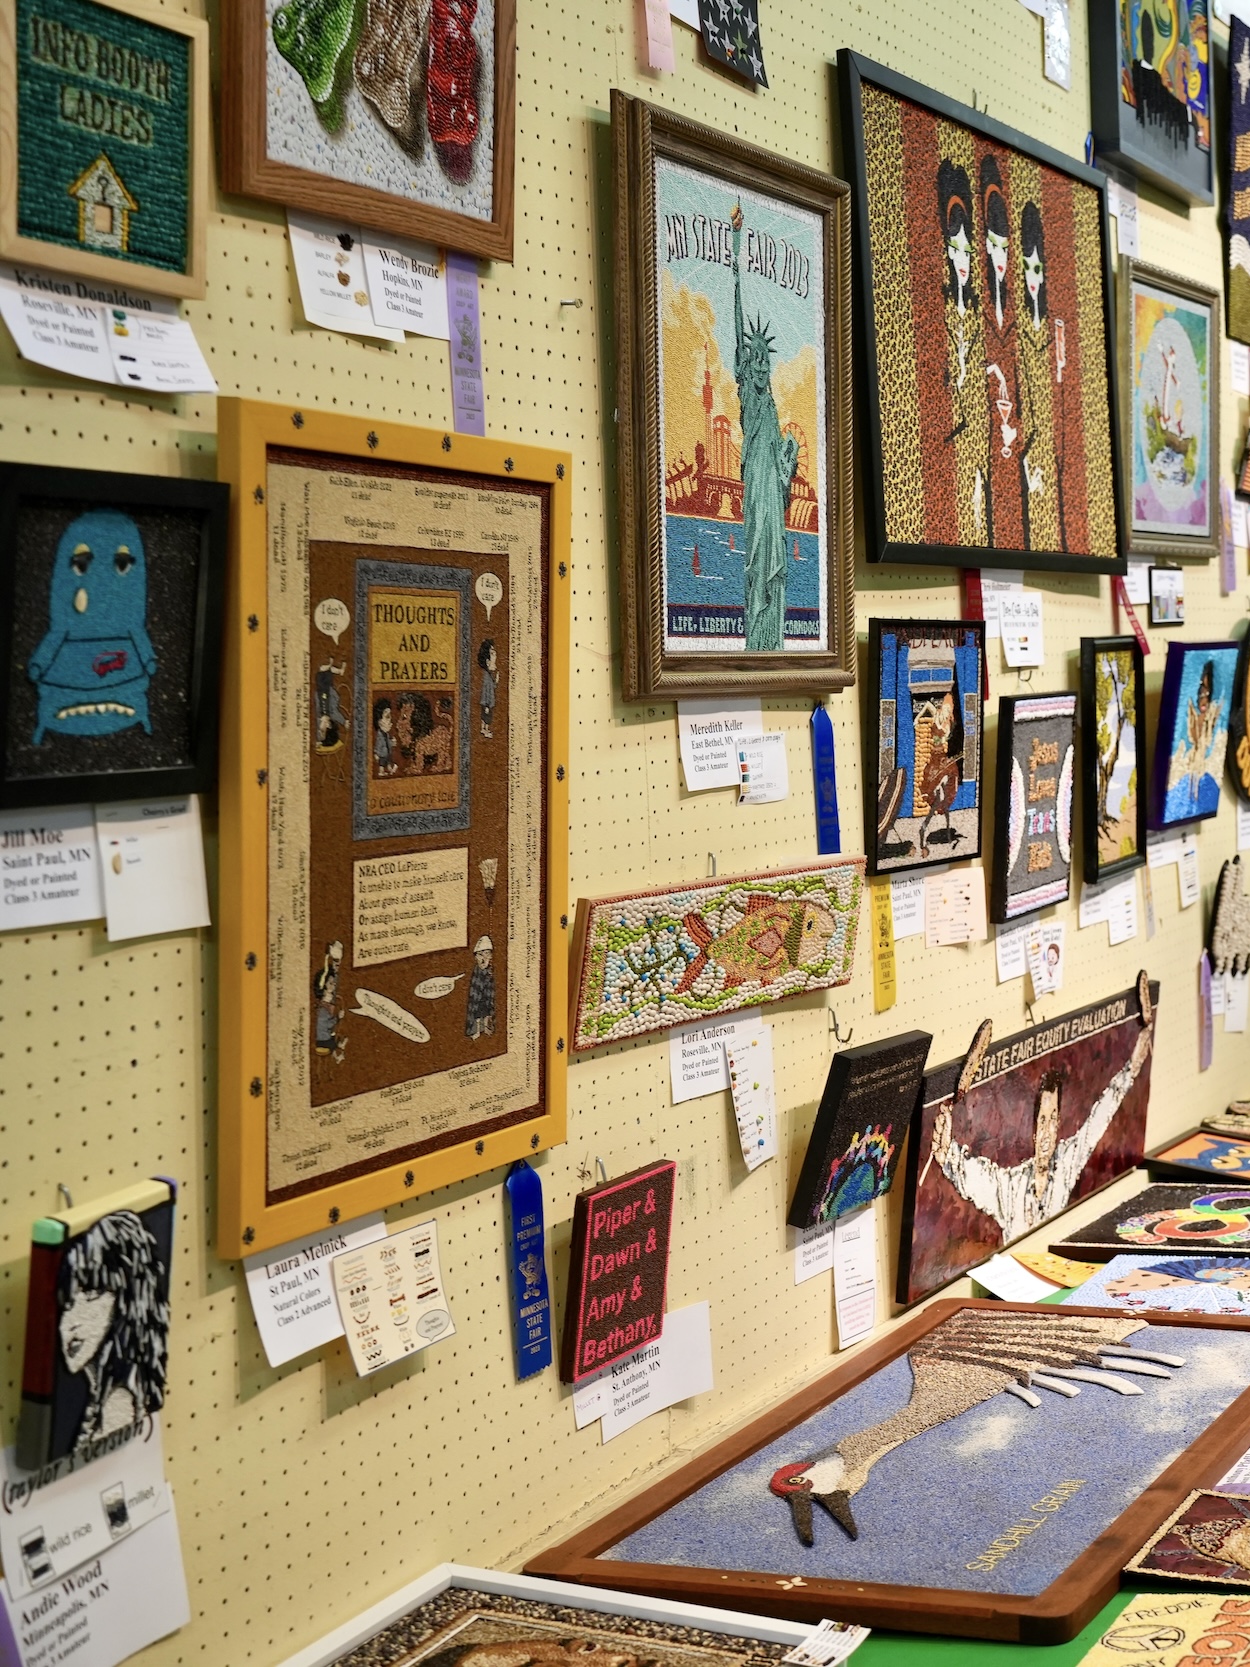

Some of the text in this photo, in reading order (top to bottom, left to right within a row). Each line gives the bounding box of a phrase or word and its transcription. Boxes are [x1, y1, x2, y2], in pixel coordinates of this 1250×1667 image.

[31, 16, 171, 101] INFO BOOTH
[60, 83, 152, 145] LADIES
[378, 249, 410, 276] Wendy
[664, 212, 810, 300] MN STATE FAIR 2023
[14, 269, 154, 312] Kristen Donaldson
[381, 269, 424, 292] Hopkins, MN
[20, 293, 99, 322] Roseville, MN
[384, 286, 423, 307] Dyed Painted
[386, 300, 401, 313] Class
[405, 306, 424, 320] Amateur
[27, 314, 96, 338] Dyed or Painted
[32, 330, 55, 345] Class
[63, 338, 100, 354] Amateur
[454, 365, 482, 382] MINNESOTA
[460, 380, 478, 394] STATE
[463, 393, 476, 406] FAIR
[327, 602, 344, 616] don't
[372, 603, 456, 626] THOUGHTS
[321, 619, 338, 632] care
[671, 616, 821, 636] LIFE, LIBERTY & CORNDOGS
[398, 633, 430, 653] AND
[380, 660, 449, 681] PRAYERS
[689, 718, 744, 737] Meredith Keller
[691, 736, 725, 750] East Bethel,
[693, 750, 728, 764] Dyed Painted
[694, 764, 706, 774] Class
[710, 761, 729, 771] Amateur
[1028, 808, 1056, 836] Trans
[1, 827, 65, 850] Jill Moe
[2, 853, 33, 872] Saint
[36, 850, 67, 868] Paul,
[69, 846, 92, 864] MN
[358, 862, 396, 878] NRA CEO
[3, 871, 78, 892] Dyed or Painted
[891, 879, 908, 891] Marta
[4, 892, 31, 907] Class
[40, 886, 80, 901] Amateur
[892, 888, 922, 902] Saint Paul, MN
[358, 913, 370, 926] Or
[358, 930, 369, 943] As
[880, 961, 891, 970] STATE
[882, 970, 891, 979] FAIR
[681, 1023, 736, 1046] Lori Anderson
[975, 999, 1128, 1082] STATE FAIR EQUITY EVALUATION
[681, 1040, 722, 1060] Roseville, MN
[681, 1061, 695, 1073] Dyed
[702, 1056, 719, 1068] Painted
[682, 1072, 695, 1083] Class
[700, 1066, 720, 1079] Amateur
[521, 1213, 537, 1227] FIRST
[593, 1188, 657, 1240] Piper &
[516, 1225, 541, 1242] PREMIUM
[841, 1227, 861, 1241] Legend
[264, 1234, 348, 1281] Laura Melnick
[589, 1227, 657, 1282] Dawn &
[269, 1266, 322, 1299] St Paul, MN
[272, 1286, 321, 1315] Natural Colors
[519, 1298, 548, 1319] MINNESOTA
[586, 1274, 643, 1327] Amy &
[277, 1312, 295, 1329] Class
[301, 1296, 332, 1317] Advanced
[526, 1312, 543, 1329] STATE
[528, 1326, 542, 1341] FAIR
[530, 1344, 541, 1355] 2023
[611, 1345, 660, 1379] Kate Martin
[611, 1360, 662, 1393] St. Anthony, MN
[613, 1392, 626, 1407] Dyed
[632, 1380, 649, 1397] Painted
[613, 1403, 626, 1418] Class
[631, 1391, 650, 1409] Amateur
[127, 1485, 155, 1510] millet
[49, 1522, 93, 1555] wild rice
[965, 1516, 1047, 1573] SANDHILL
[20, 1559, 103, 1632] Andie Wood
[22, 1580, 110, 1652] Minneapolis, MN
[1122, 1597, 1214, 1623] FREDDIE
[58, 1616, 88, 1645] Painted
[56, 1632, 92, 1662] Amateur
